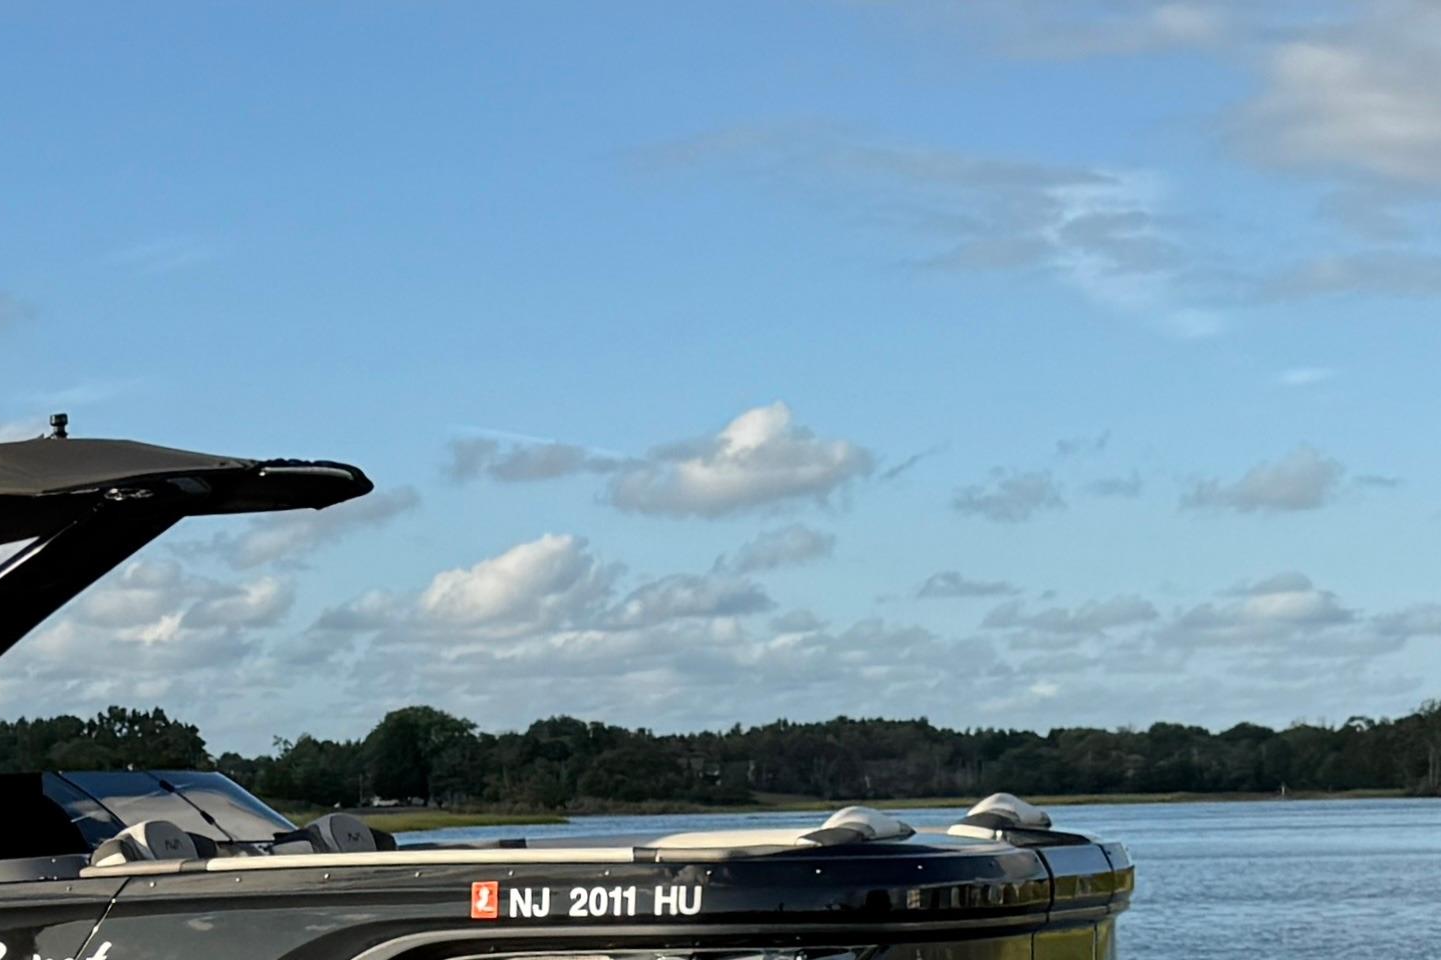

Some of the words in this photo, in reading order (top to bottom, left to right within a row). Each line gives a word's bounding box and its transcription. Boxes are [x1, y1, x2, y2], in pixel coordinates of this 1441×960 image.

[509, 887, 550, 918] NJ
[568, 886, 636, 916] 2011
[654, 885, 702, 916] HU
